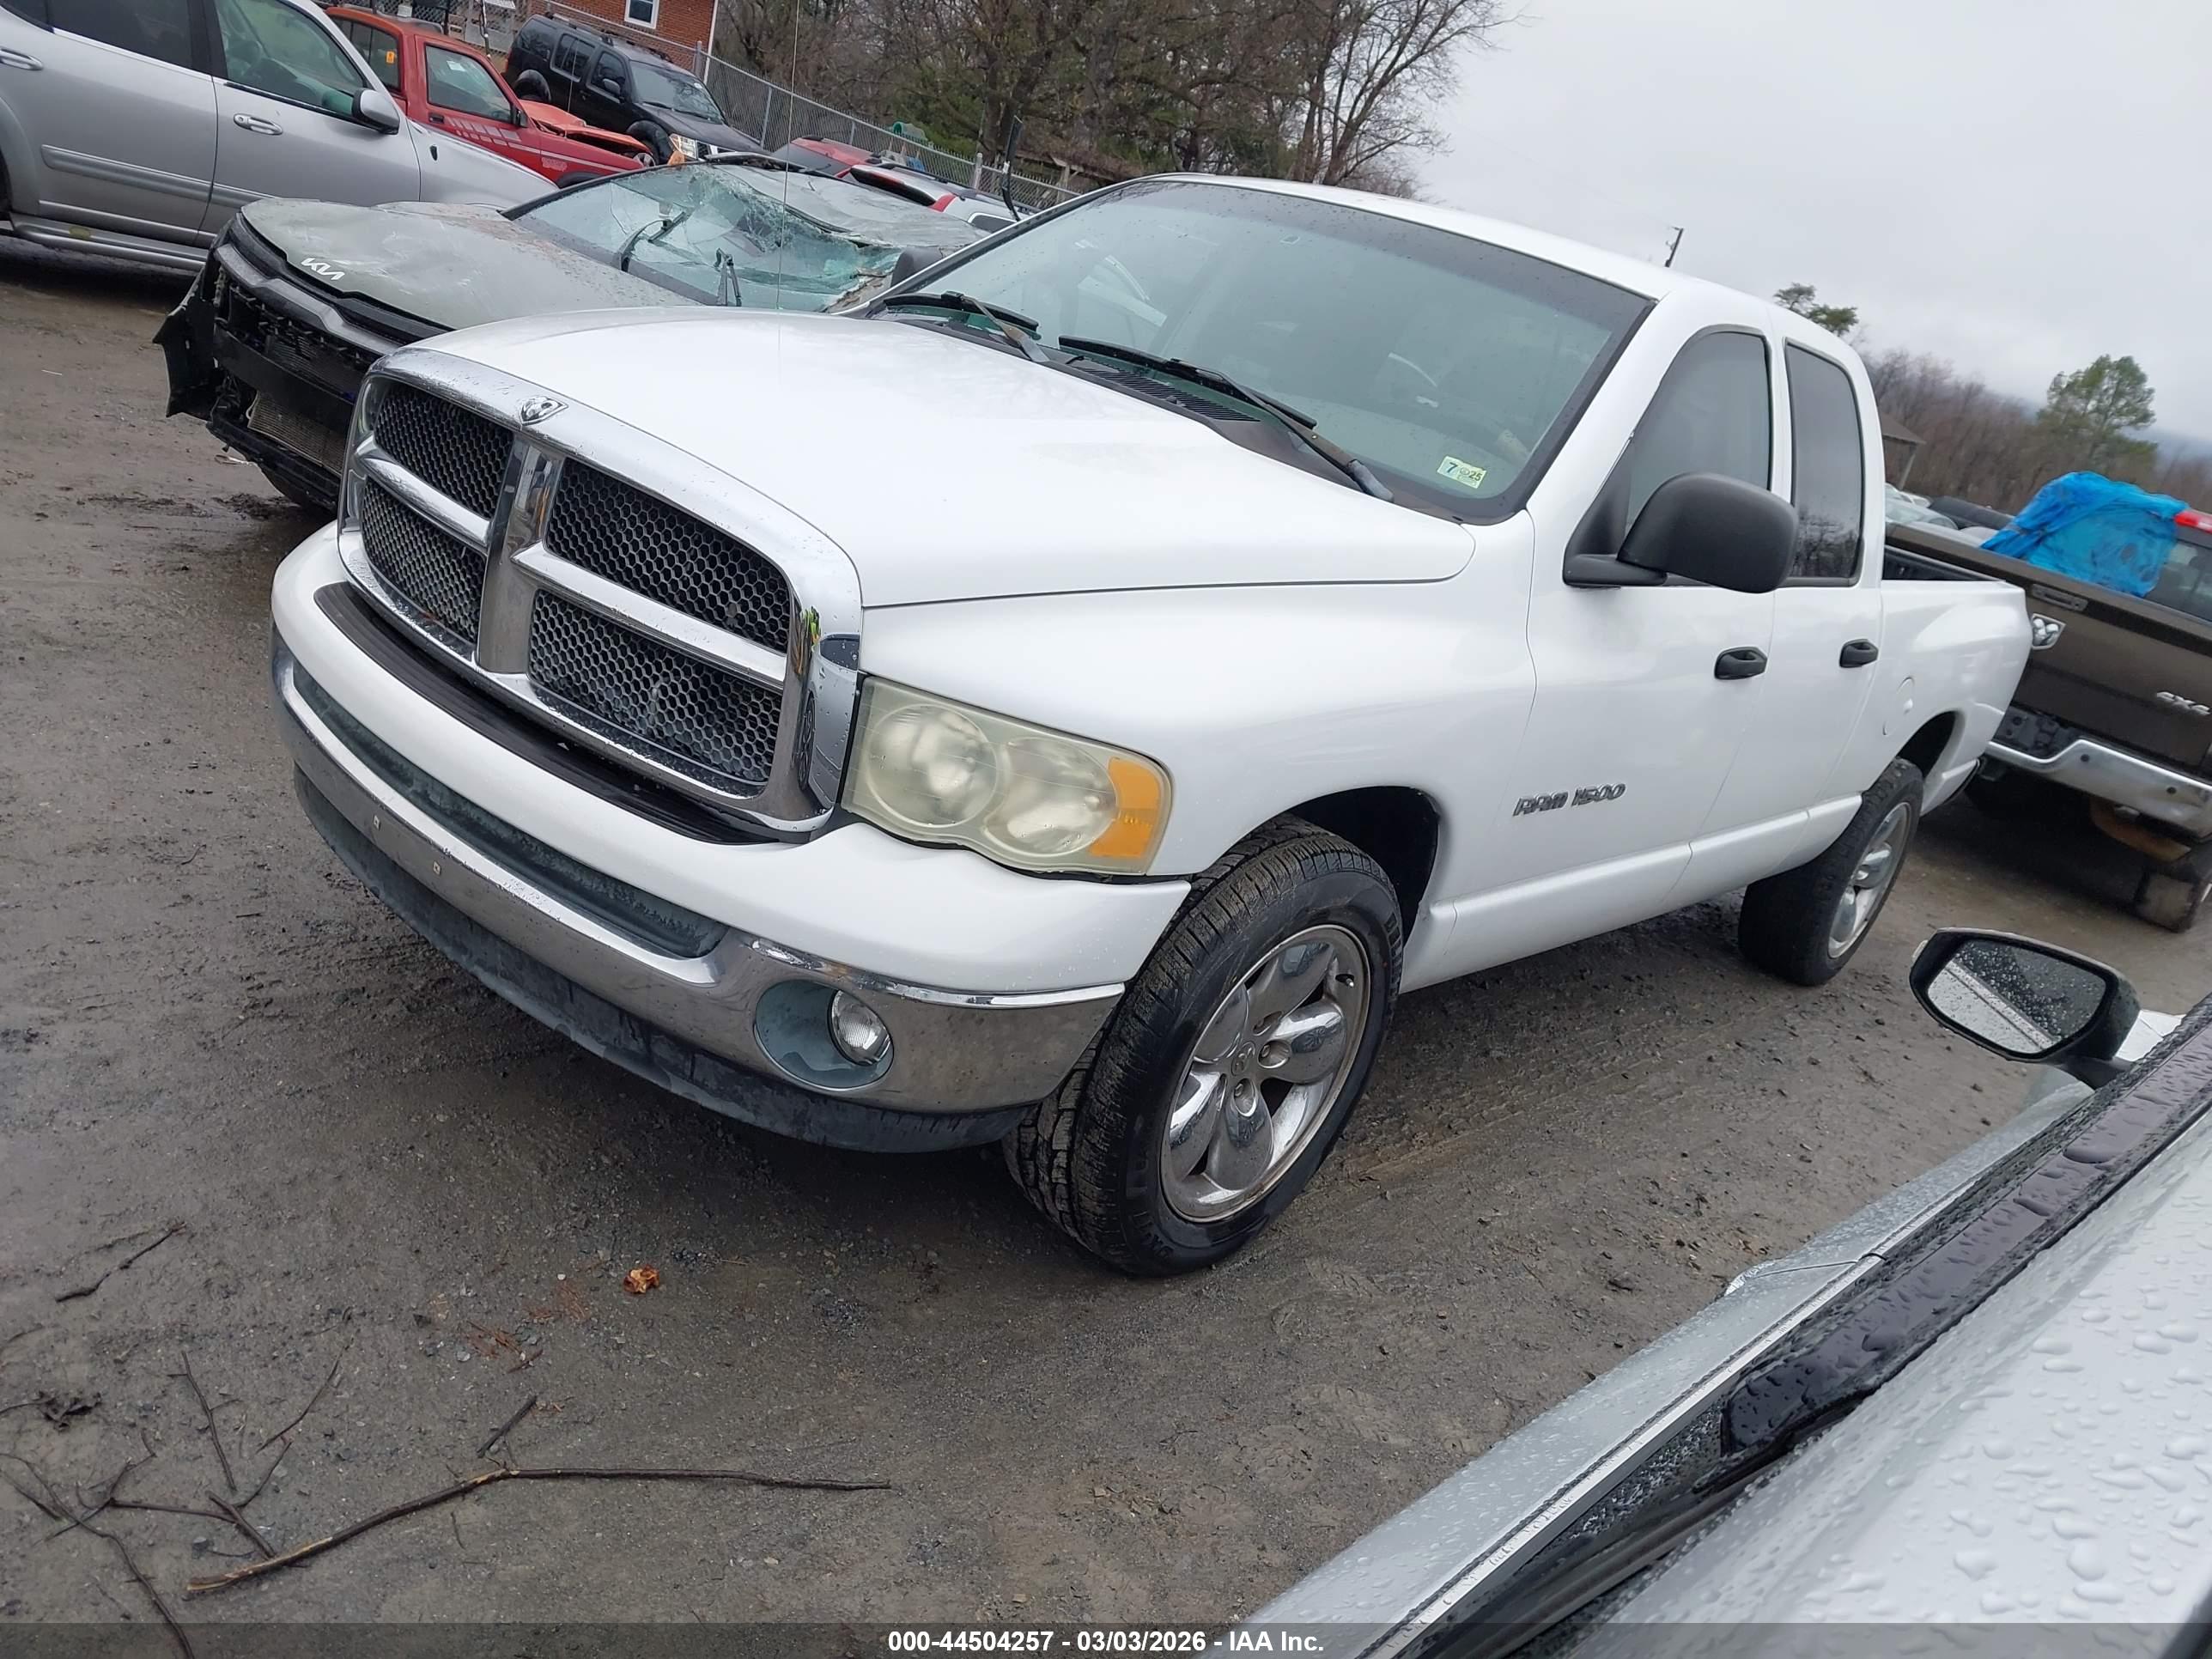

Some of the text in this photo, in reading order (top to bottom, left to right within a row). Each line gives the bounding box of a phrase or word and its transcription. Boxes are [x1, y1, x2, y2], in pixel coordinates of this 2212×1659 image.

[301, 257, 345, 281] KIA
[1446, 461, 1482, 482] 7 25
[1512, 783, 1626, 817] RAM 1500
